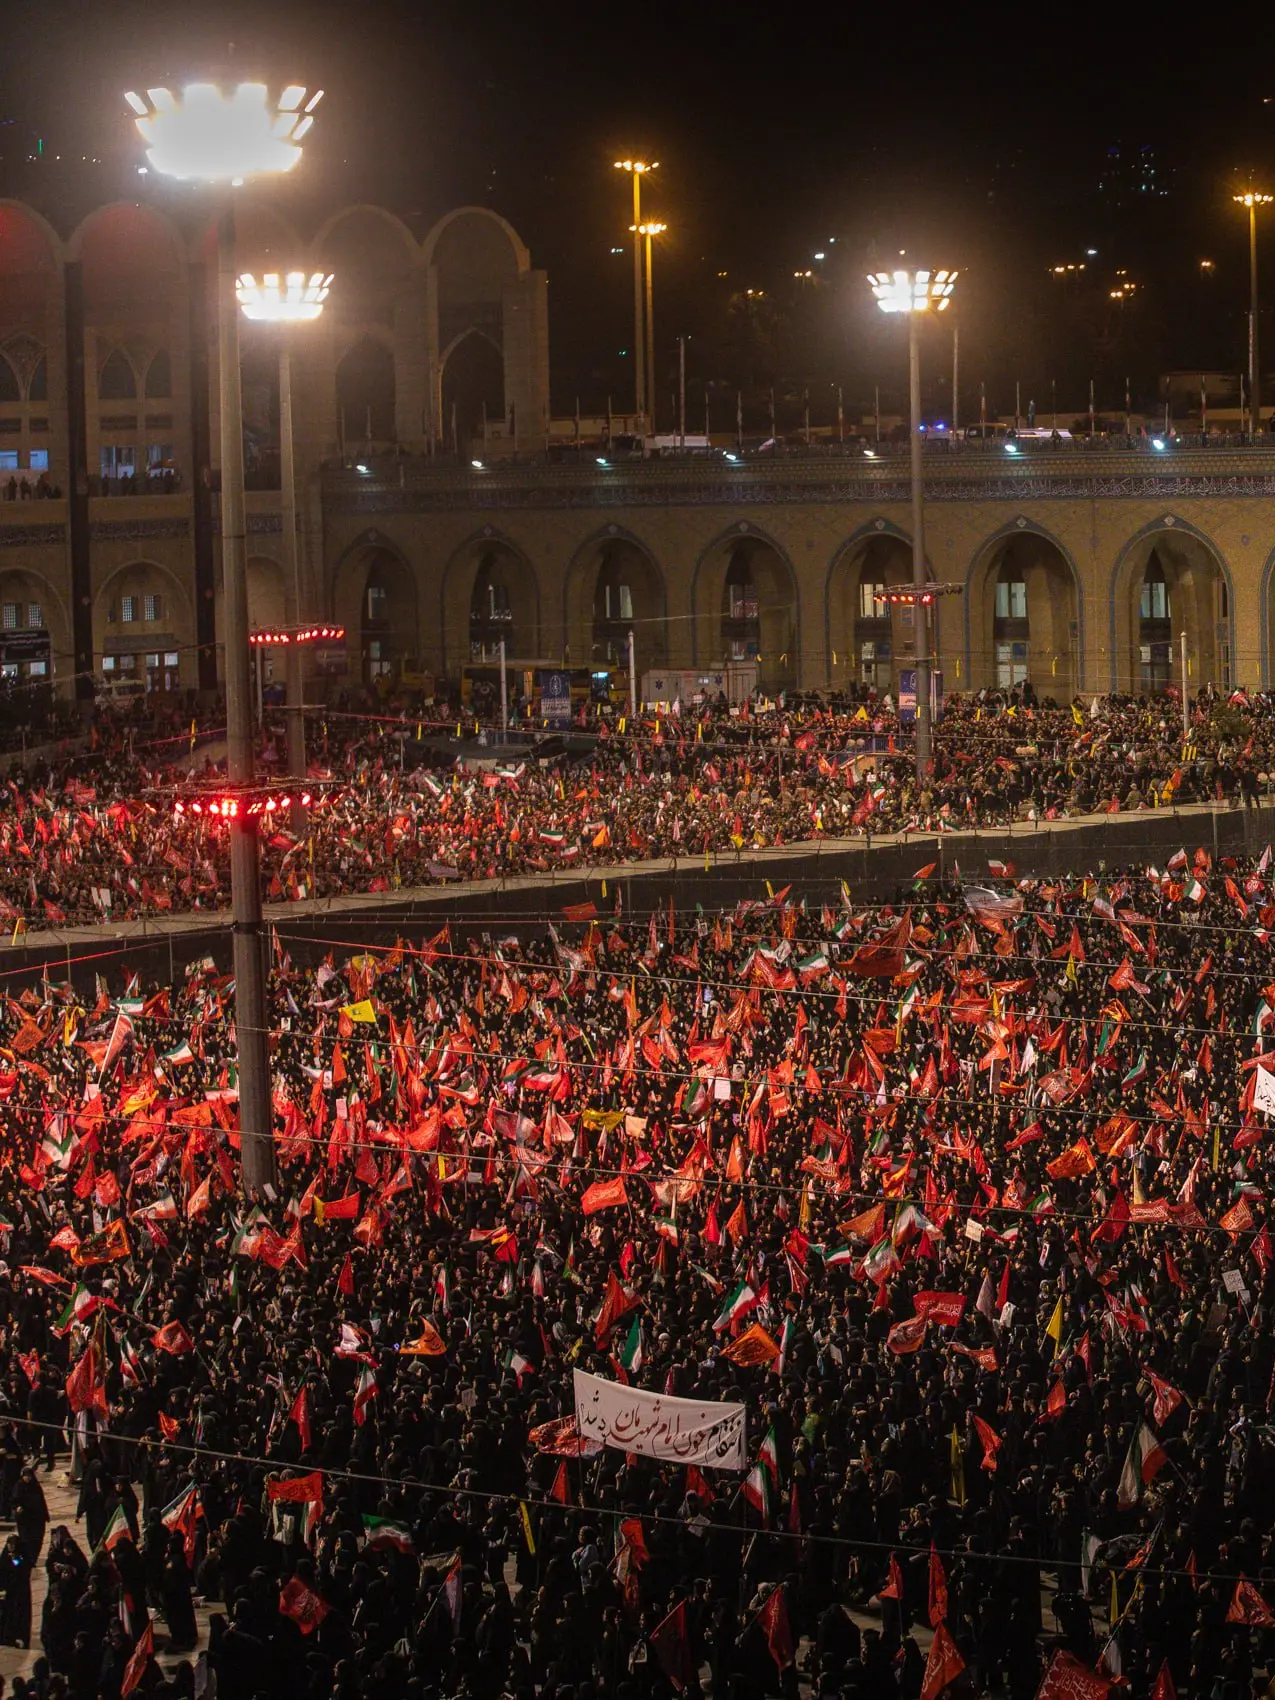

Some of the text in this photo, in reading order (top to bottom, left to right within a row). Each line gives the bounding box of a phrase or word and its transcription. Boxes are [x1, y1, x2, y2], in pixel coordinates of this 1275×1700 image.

[651, 1413, 681, 1457] امام
[673, 1412, 706, 1457] خون
[705, 1416, 742, 1464] انتقام
